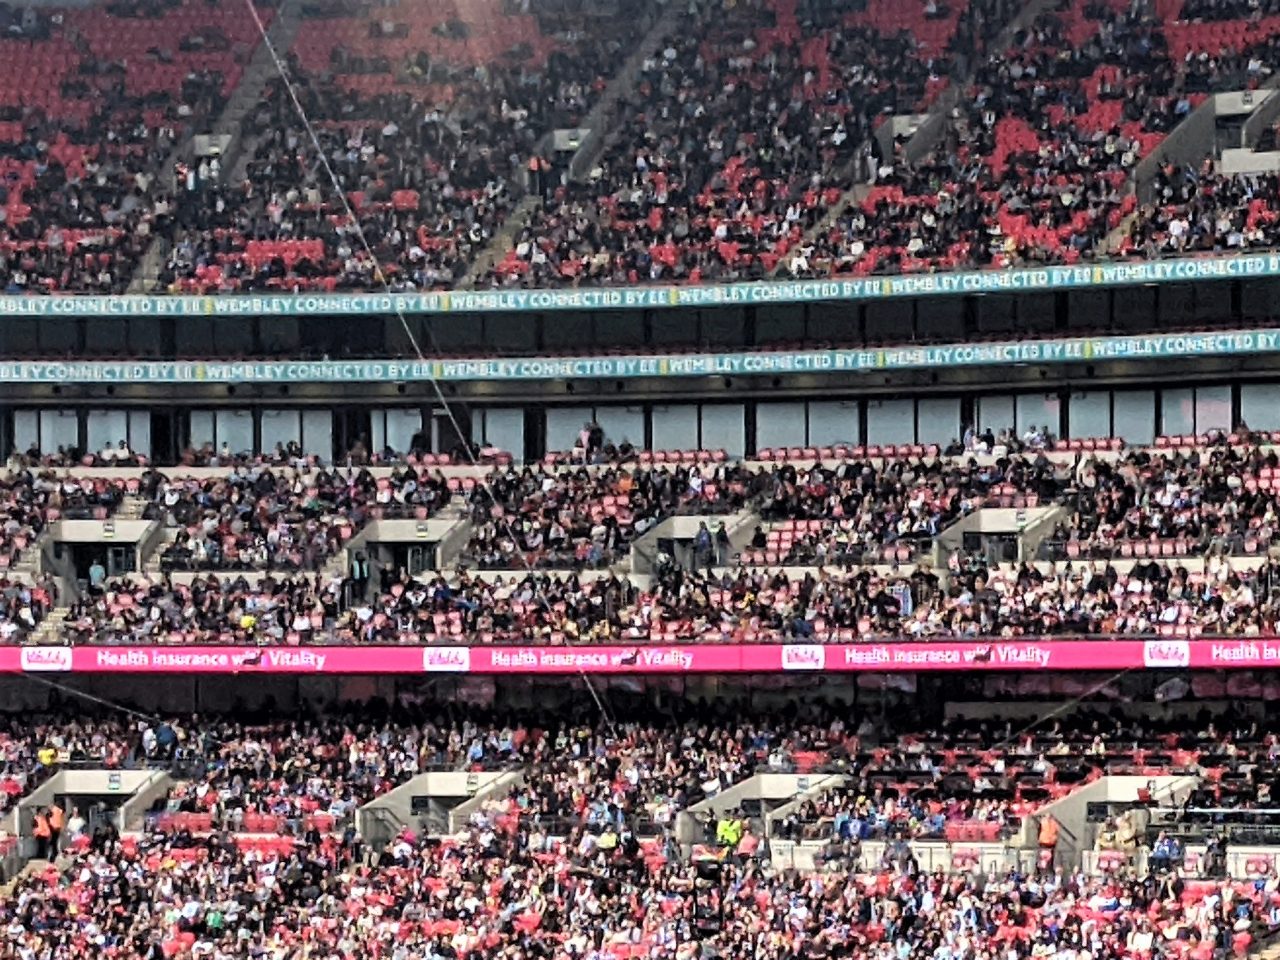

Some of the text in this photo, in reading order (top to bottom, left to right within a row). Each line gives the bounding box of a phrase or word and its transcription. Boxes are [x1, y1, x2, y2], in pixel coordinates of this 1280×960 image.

[1102, 265, 1173, 281] WEMBLEY
[1177, 259, 1264, 276] CONNECTED
[892, 277, 959, 292] WEMBLEY
[963, 272, 1047, 289] CONNECTED
[1053, 271, 1073, 283] BY
[450, 295, 525, 309] WEMBLEY
[530, 292, 621, 307] CONNECTED
[626, 291, 645, 304] BY
[679, 287, 747, 302] WEMBLEY
[752, 283, 838, 299] CONNECTED
[843, 282, 861, 295] BY
[51, 299, 151, 312] CONNECTED
[157, 300, 182, 312] BY
[216, 299, 293, 312] WEMBLEY
[295, 298, 391, 311] CONNECTED
[396, 298, 417, 310] BY
[1092, 340, 1162, 355] WEMBLEY
[1166, 335, 1252, 352] CONNECTED
[1258, 334, 1276, 347] BY
[670, 358, 740, 371] WEMBLEY
[744, 354, 832, 369] CONNECTED
[836, 354, 855, 366] BY
[885, 350, 952, 364] WEMBLEY
[955, 346, 1038, 362] CONNECTED
[1044, 345, 1061, 358] BY
[47, 365, 143, 377] CONNECTED
[149, 366, 168, 377] BY
[205, 366, 284, 377] WEMBLEY
[287, 365, 381, 377] CONNECTED
[389, 365, 408, 377] BY
[442, 363, 517, 376] WEMBLEY
[521, 361, 612, 375] CONNECTED
[617, 360, 636, 373] BY
[97, 651, 149, 666] Health
[152, 652, 228, 666] insurance
[269, 651, 326, 670] Vitality
[491, 651, 537, 666] Health
[541, 651, 608, 666] insurance
[644, 650, 693, 668] Vitality
[845, 648, 889, 664] Health
[894, 649, 960, 663] insurance
[997, 646, 1050, 666] Vitality
[1212, 643, 1259, 660] Health
